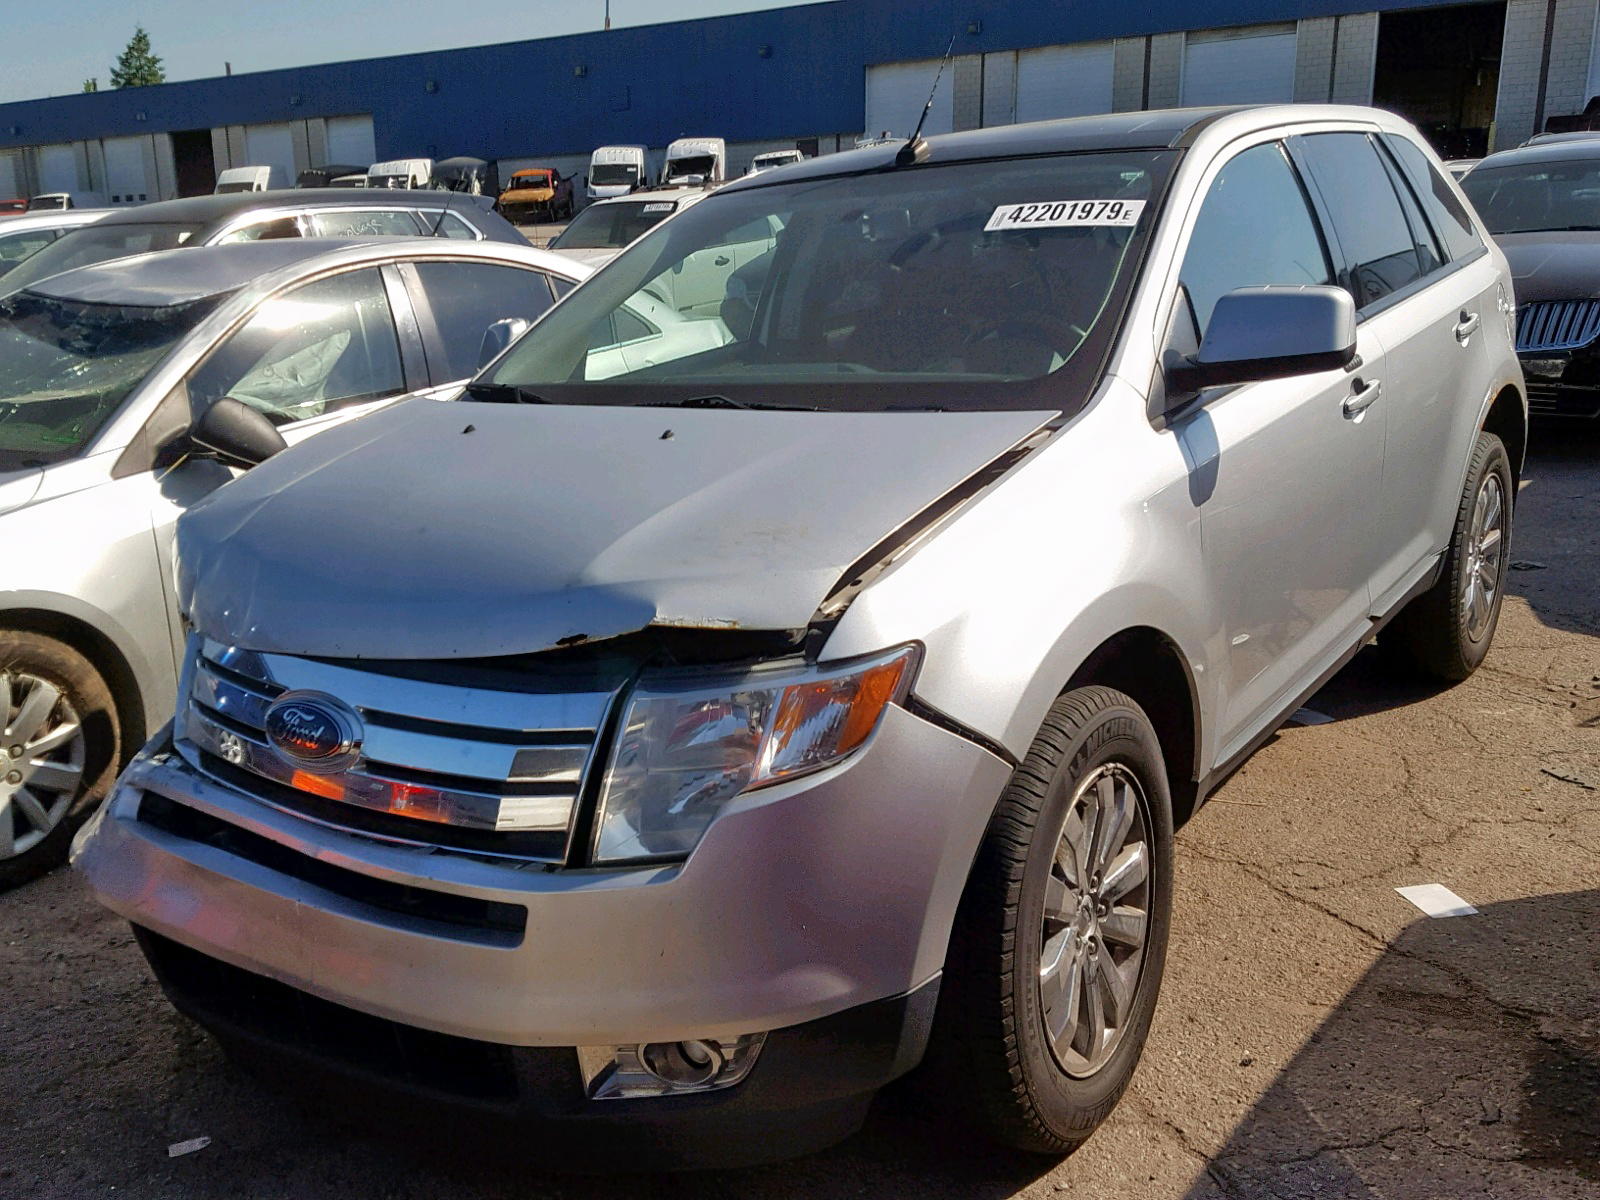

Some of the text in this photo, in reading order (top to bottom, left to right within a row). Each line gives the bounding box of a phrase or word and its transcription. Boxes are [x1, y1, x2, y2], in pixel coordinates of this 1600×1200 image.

[1008, 201, 1124, 223] 42201979
[1122, 209, 1133, 221] E
[280, 708, 325, 749] Ford
[1087, 718, 1141, 757] MICHELI
